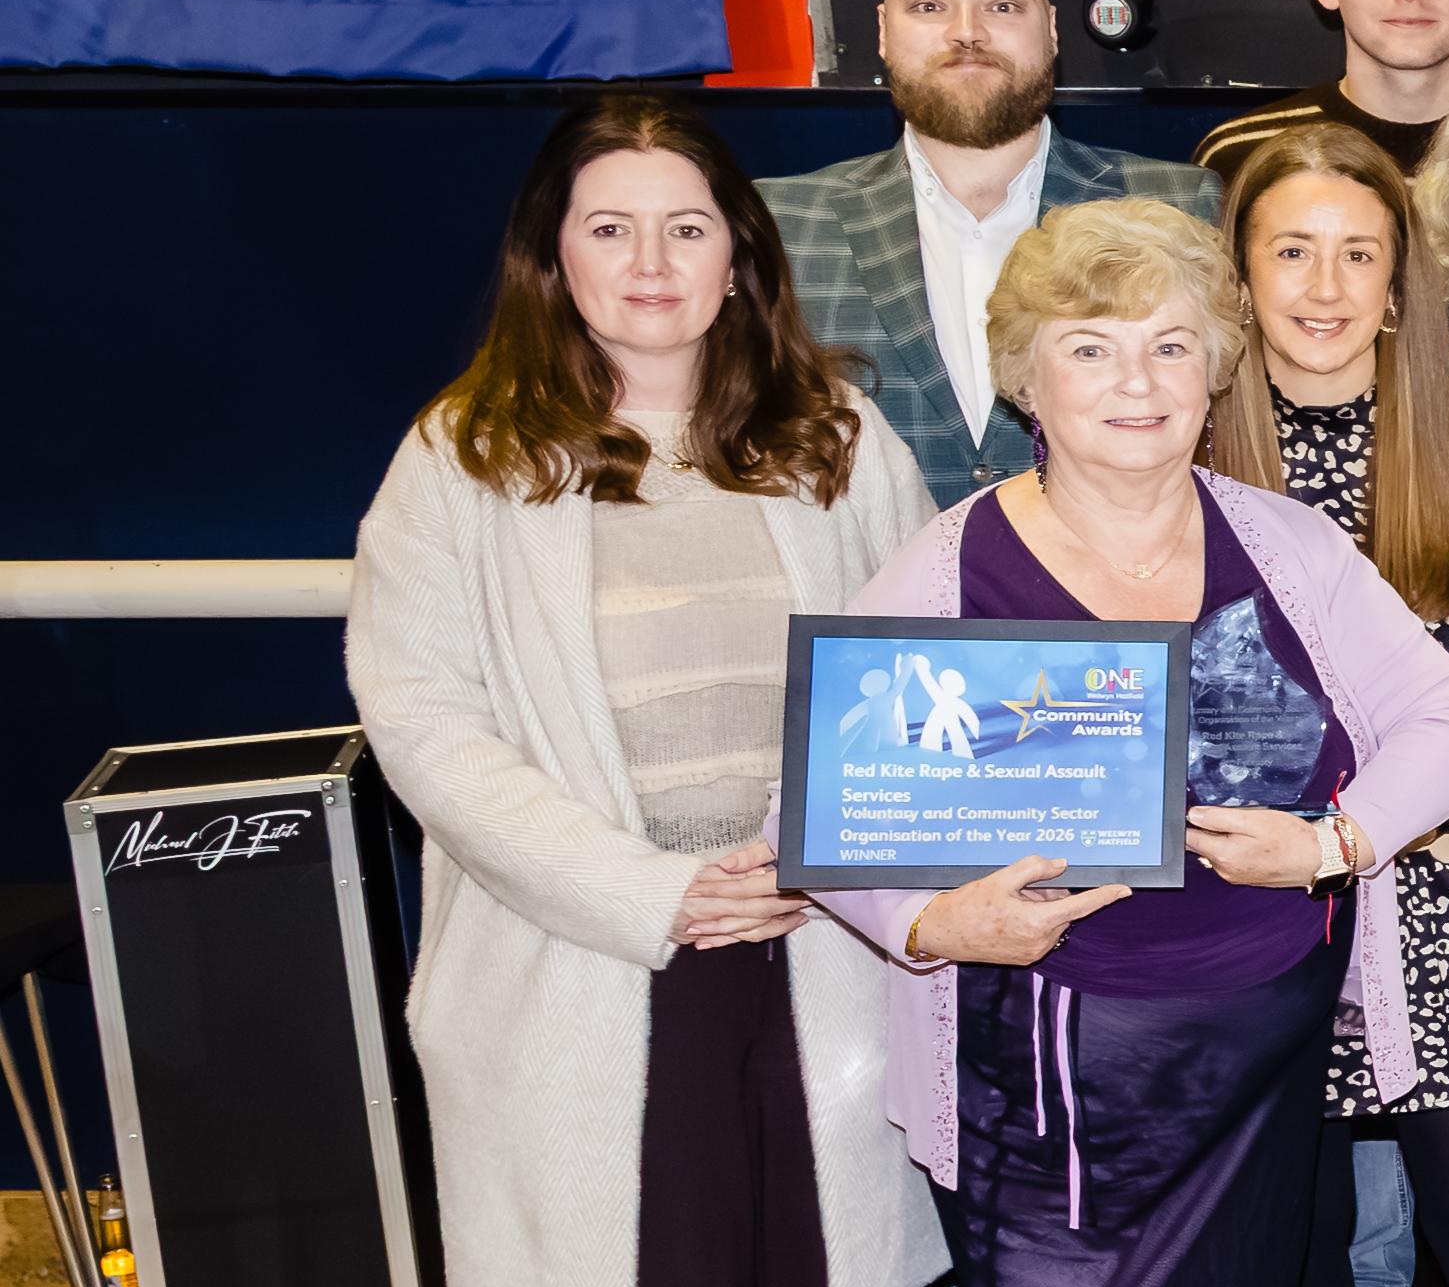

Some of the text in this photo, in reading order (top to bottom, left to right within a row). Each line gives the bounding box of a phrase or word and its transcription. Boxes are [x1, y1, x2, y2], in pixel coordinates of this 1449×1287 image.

[1085, 667, 1144, 692] ONE
[1033, 710, 1143, 724] Community
[1072, 724, 1143, 736] Awards
[843, 764, 1106, 781] Red Kite Rape & Sexual Assault
[842, 788, 911, 803] Services
[842, 806, 1099, 822] Voluntary and Community Sector
[839, 828, 1075, 845] Organisation of the Year 2026
[1097, 830, 1141, 838] WELWYN
[1098, 838, 1140, 846] HATFIELD
[840, 849, 896, 861] WINNER
